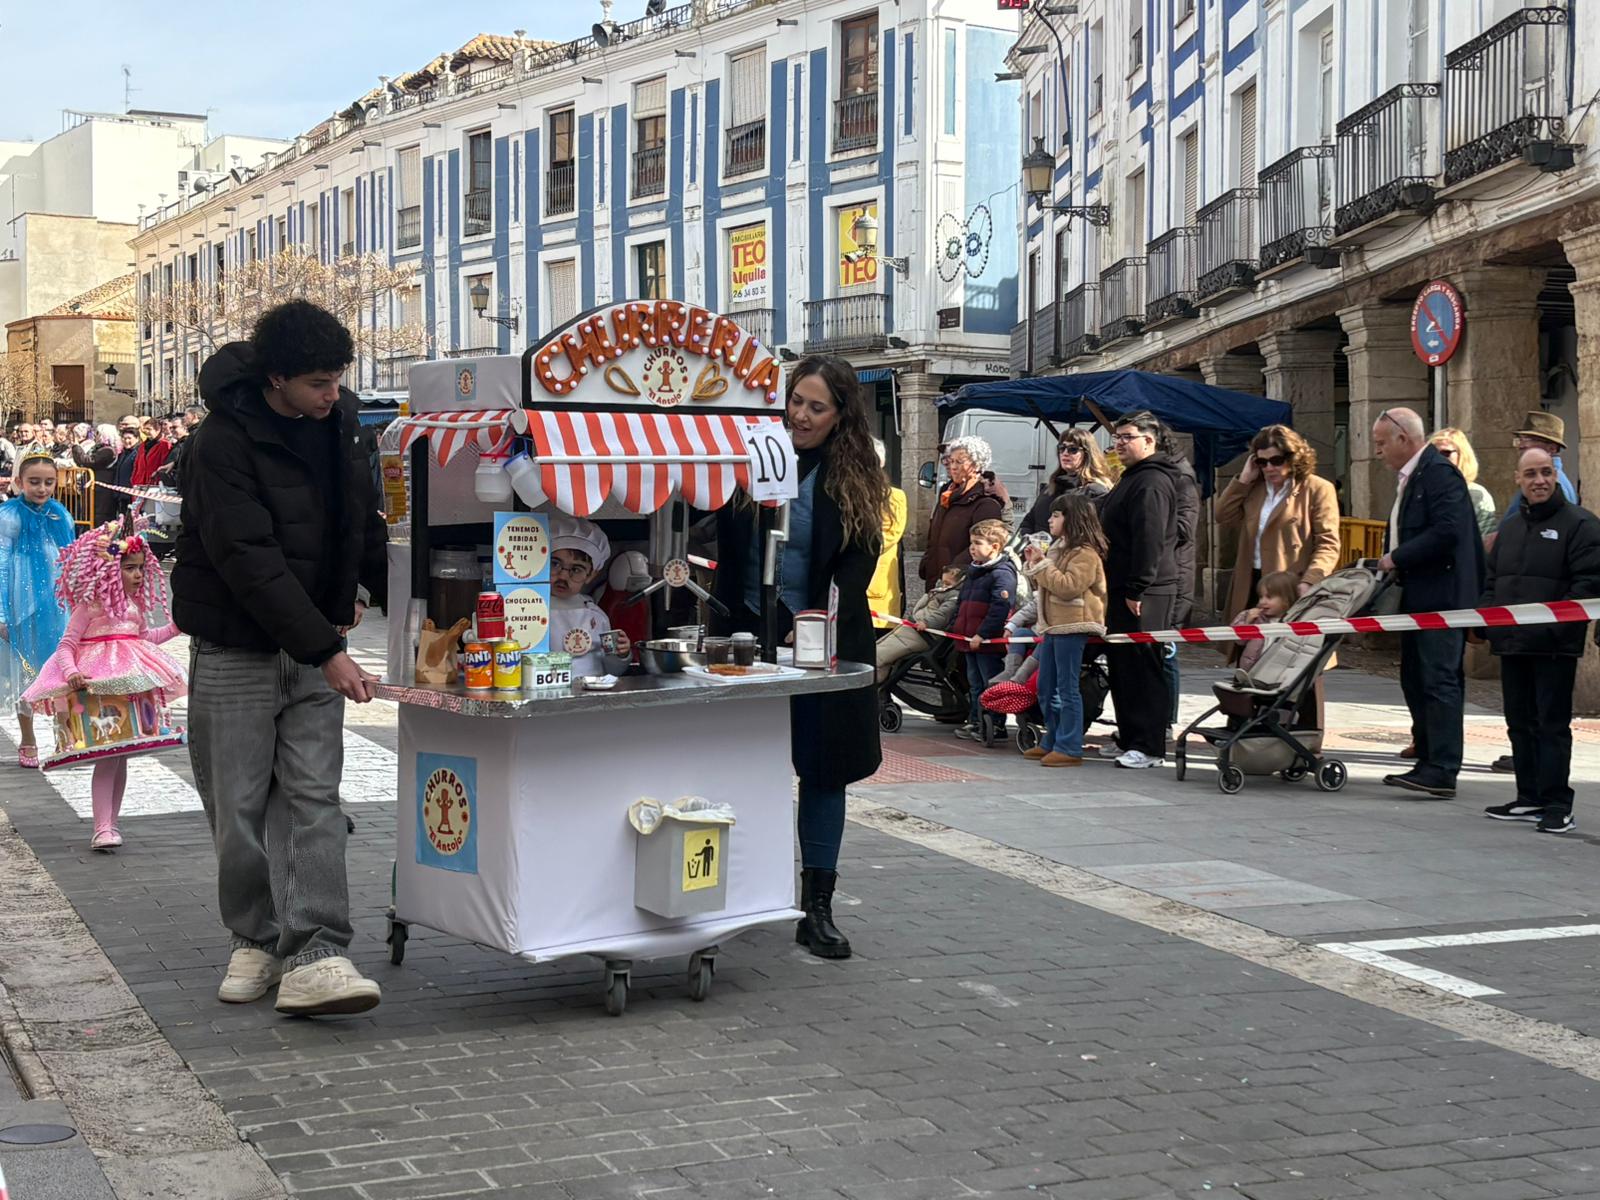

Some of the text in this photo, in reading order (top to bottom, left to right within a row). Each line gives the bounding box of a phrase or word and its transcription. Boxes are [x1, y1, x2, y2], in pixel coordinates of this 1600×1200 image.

[732, 240, 766, 268] TEO
[841, 257, 877, 284] TEO
[535, 301, 780, 404] CHURRERIA
[643, 347, 688, 374] CHURROS
[748, 433, 786, 483] 10
[507, 525, 539, 533] TENEMOS
[536, 672, 570, 685] BOTE
[425, 769, 467, 808] CHURROS
